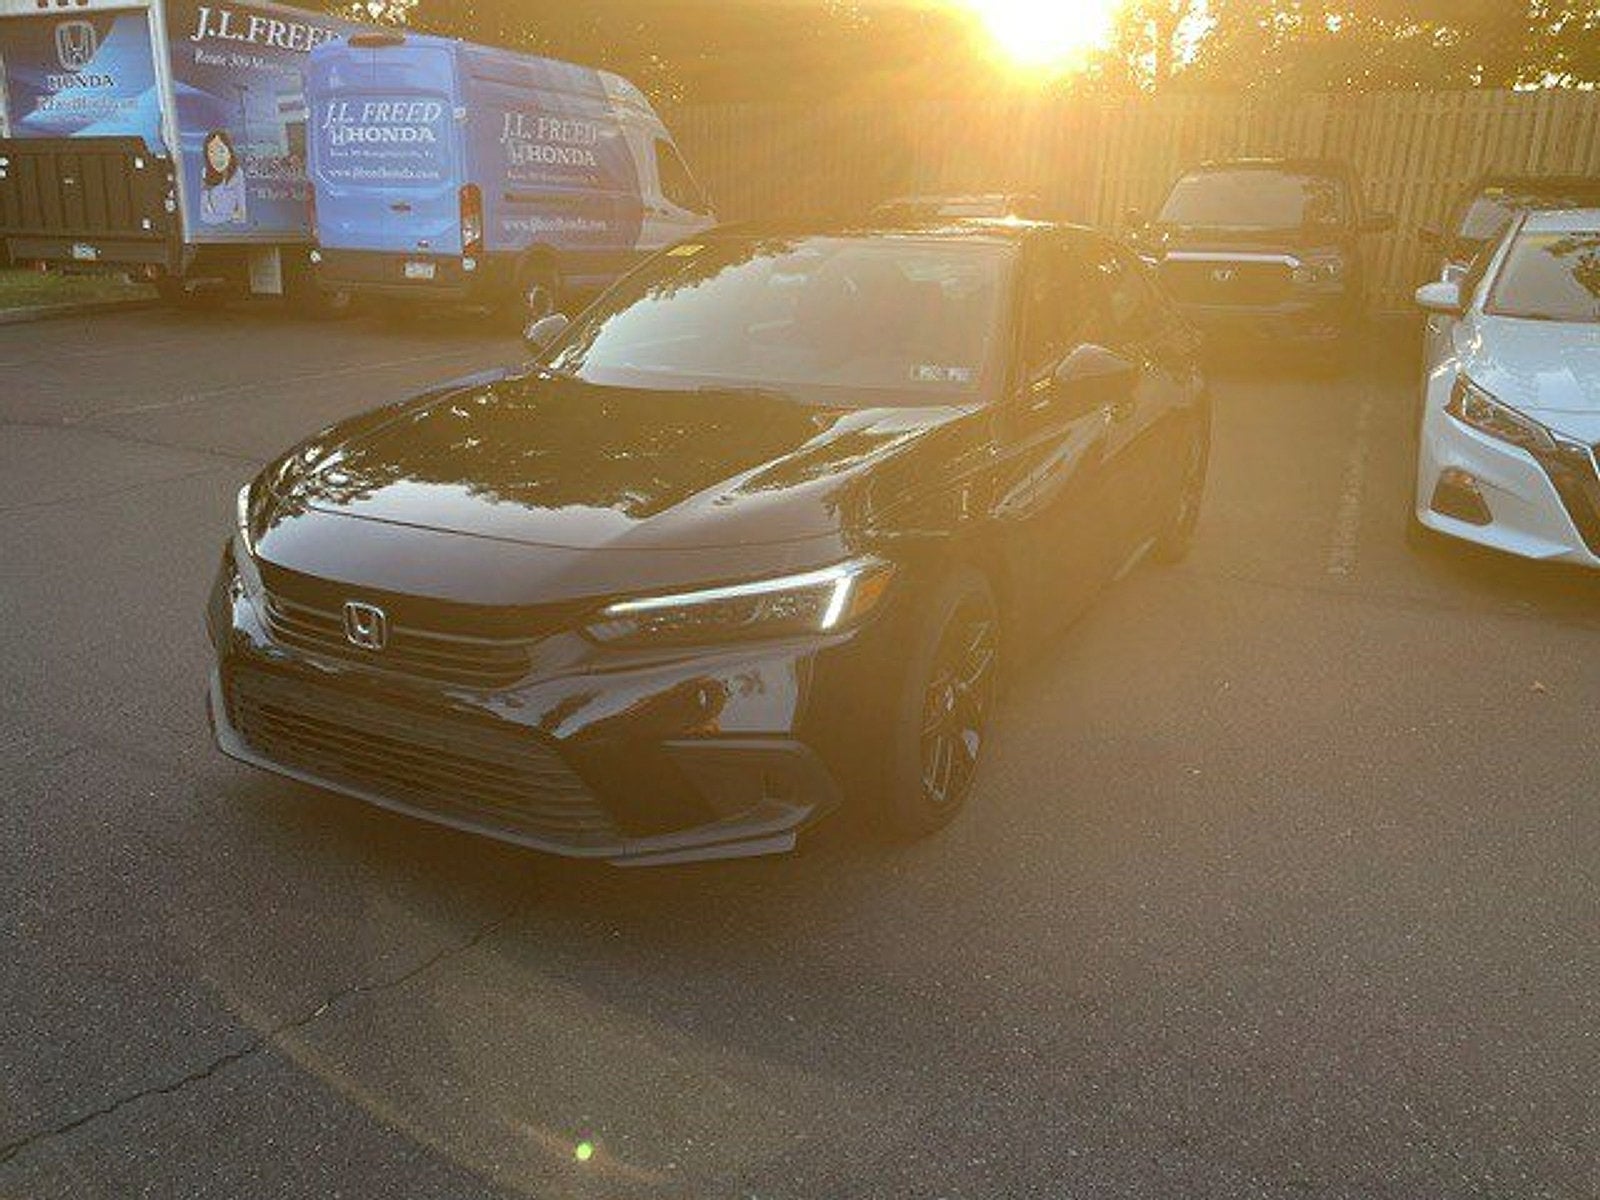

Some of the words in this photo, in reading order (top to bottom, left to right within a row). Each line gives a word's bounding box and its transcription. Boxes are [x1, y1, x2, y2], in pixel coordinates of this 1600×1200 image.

[47, 74, 116, 89] HONDA
[361, 101, 441, 123] FREED
[347, 126, 437, 142] HONDA
[538, 117, 598, 144] FREED
[523, 144, 597, 166] HONDA
